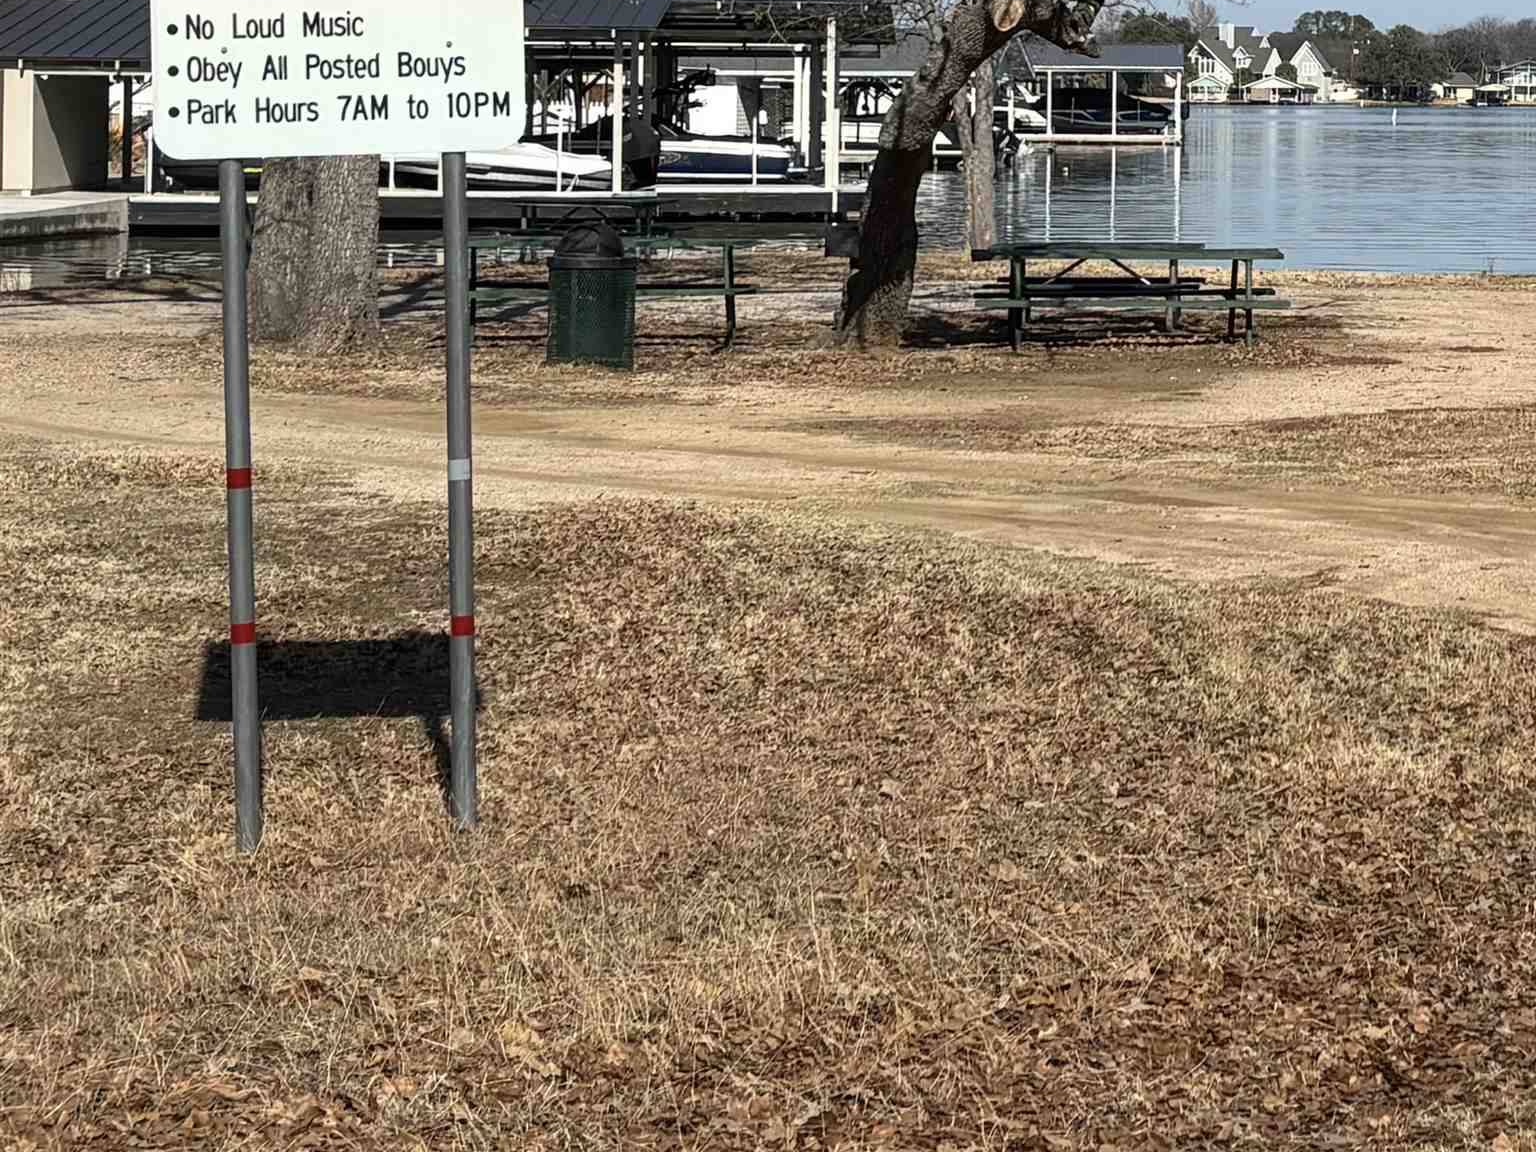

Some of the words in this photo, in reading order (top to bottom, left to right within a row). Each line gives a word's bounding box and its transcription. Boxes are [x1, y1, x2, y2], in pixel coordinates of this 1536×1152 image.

[186, 15, 214, 39] No
[233, 14, 285, 38] Loud
[303, 12, 364, 37] Music
[188, 56, 242, 88] Obey
[263, 55, 288, 80] All
[306, 53, 380, 79] Posted
[398, 52, 466, 83] Bouys
[188, 100, 236, 124] Park
[256, 98, 319, 123] Hours
[338, 95, 389, 121] 7AM
[407, 95, 429, 120] to
[448, 92, 511, 117] 10PM
